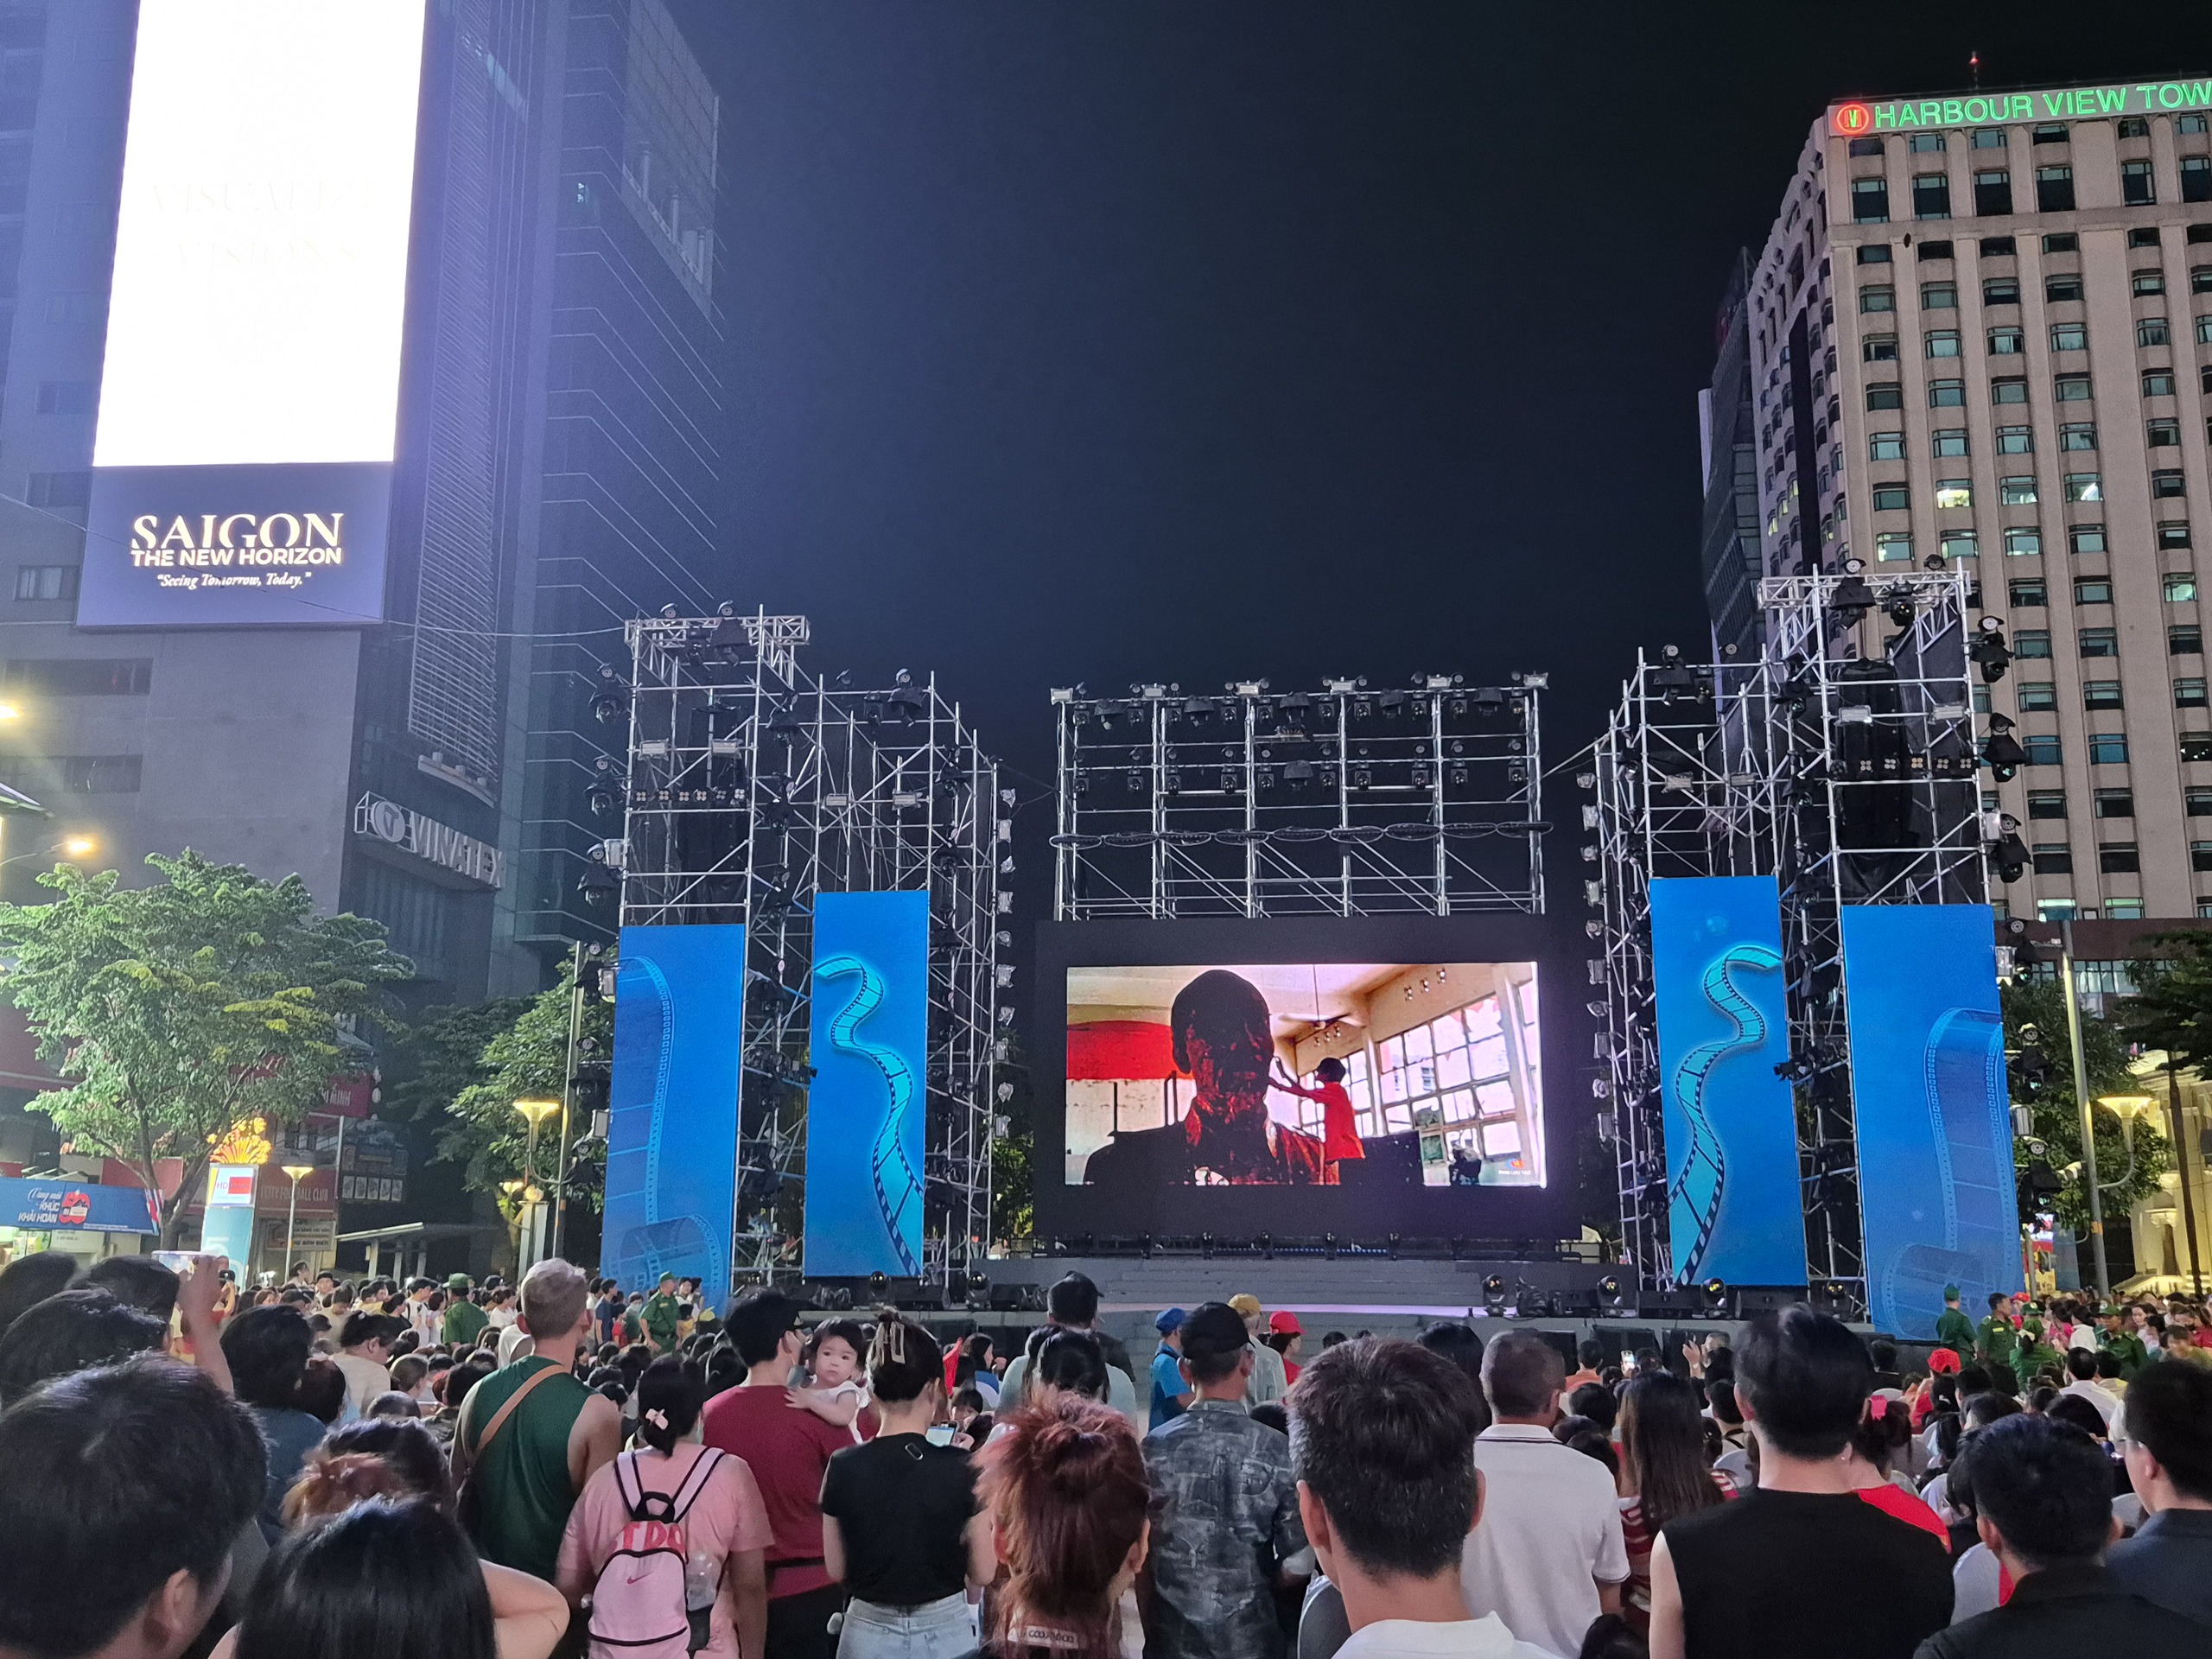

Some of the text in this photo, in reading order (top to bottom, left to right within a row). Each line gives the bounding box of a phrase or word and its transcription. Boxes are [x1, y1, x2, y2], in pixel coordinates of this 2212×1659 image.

[1874, 94, 2033, 130] HARBOUR
[2042, 89, 2127, 117] VIEW
[2135, 80, 2212, 109] TOW
[130, 512, 345, 550] SAIGON
[130, 546, 342, 568] THE NEW HORIZON
[409, 810, 506, 888] VINATEX
